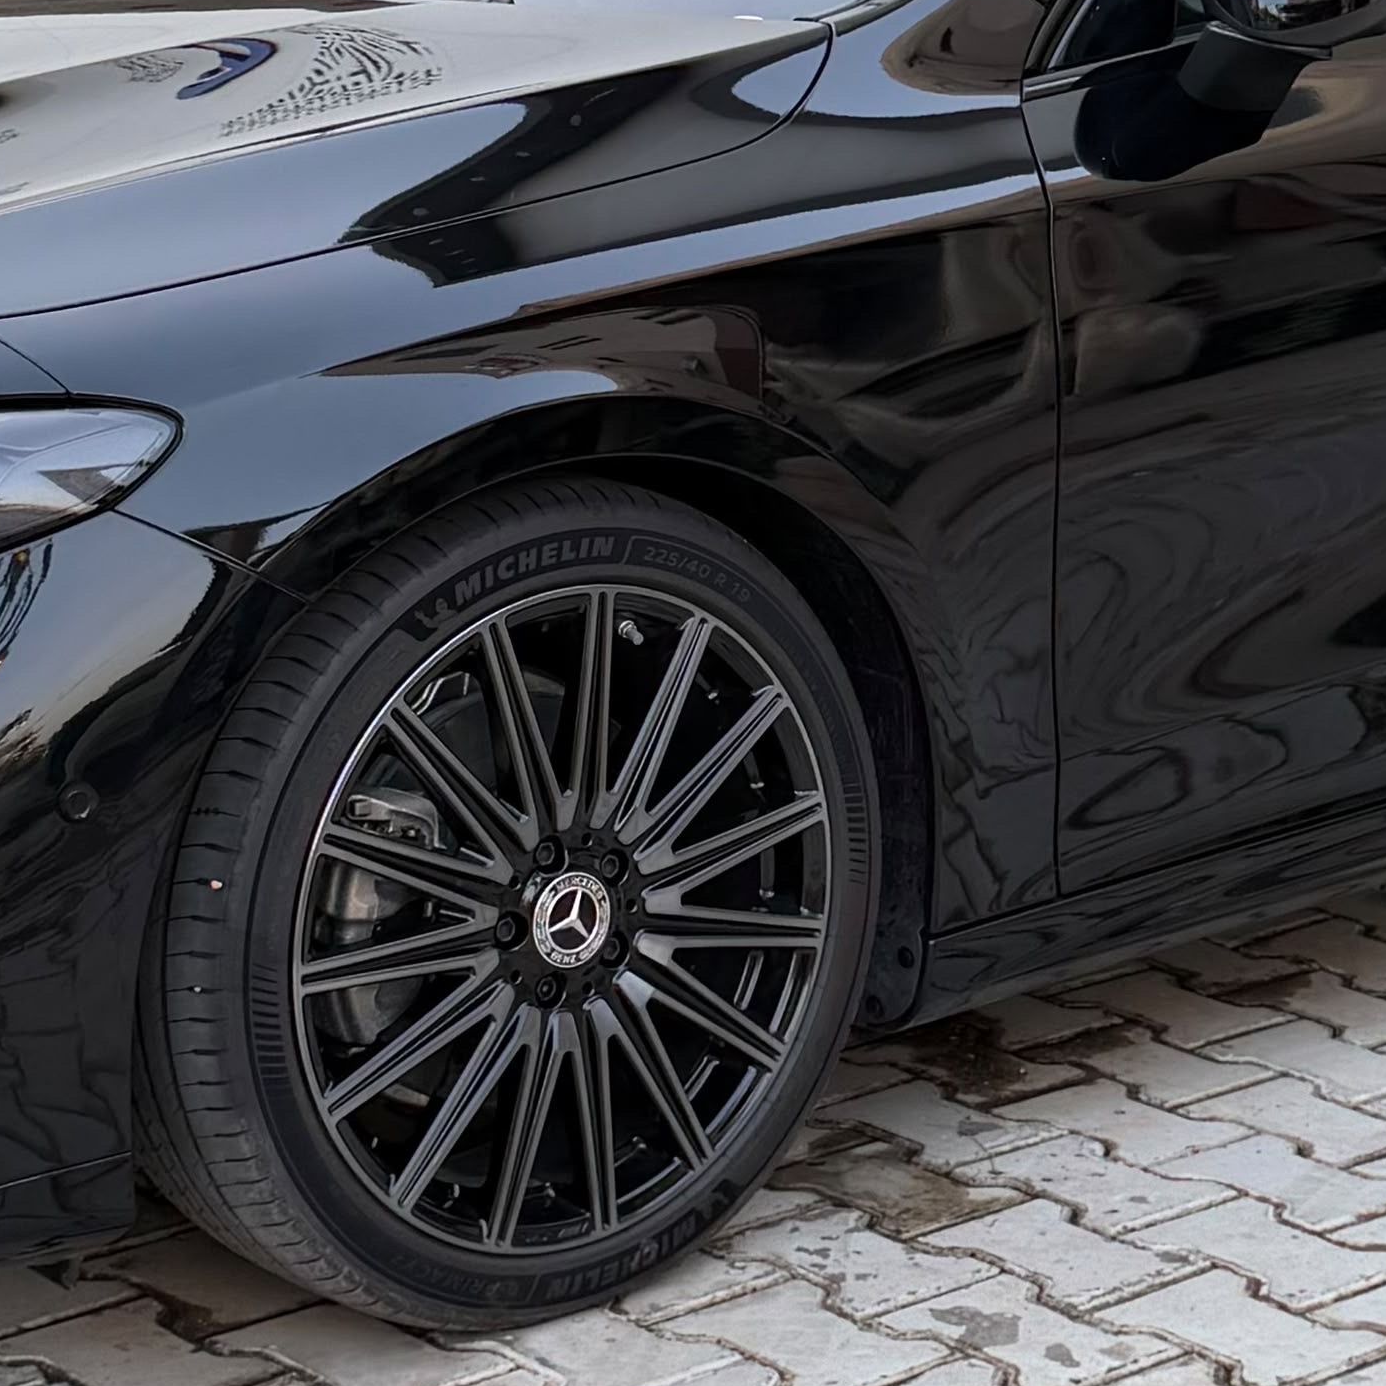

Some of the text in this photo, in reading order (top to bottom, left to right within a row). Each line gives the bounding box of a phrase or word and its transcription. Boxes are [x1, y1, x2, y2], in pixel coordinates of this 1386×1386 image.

[453, 536, 615, 606] MICHELIN
[643, 546, 753, 603] 225/40 R 19
[547, 1208, 698, 1300] MICHELIN
